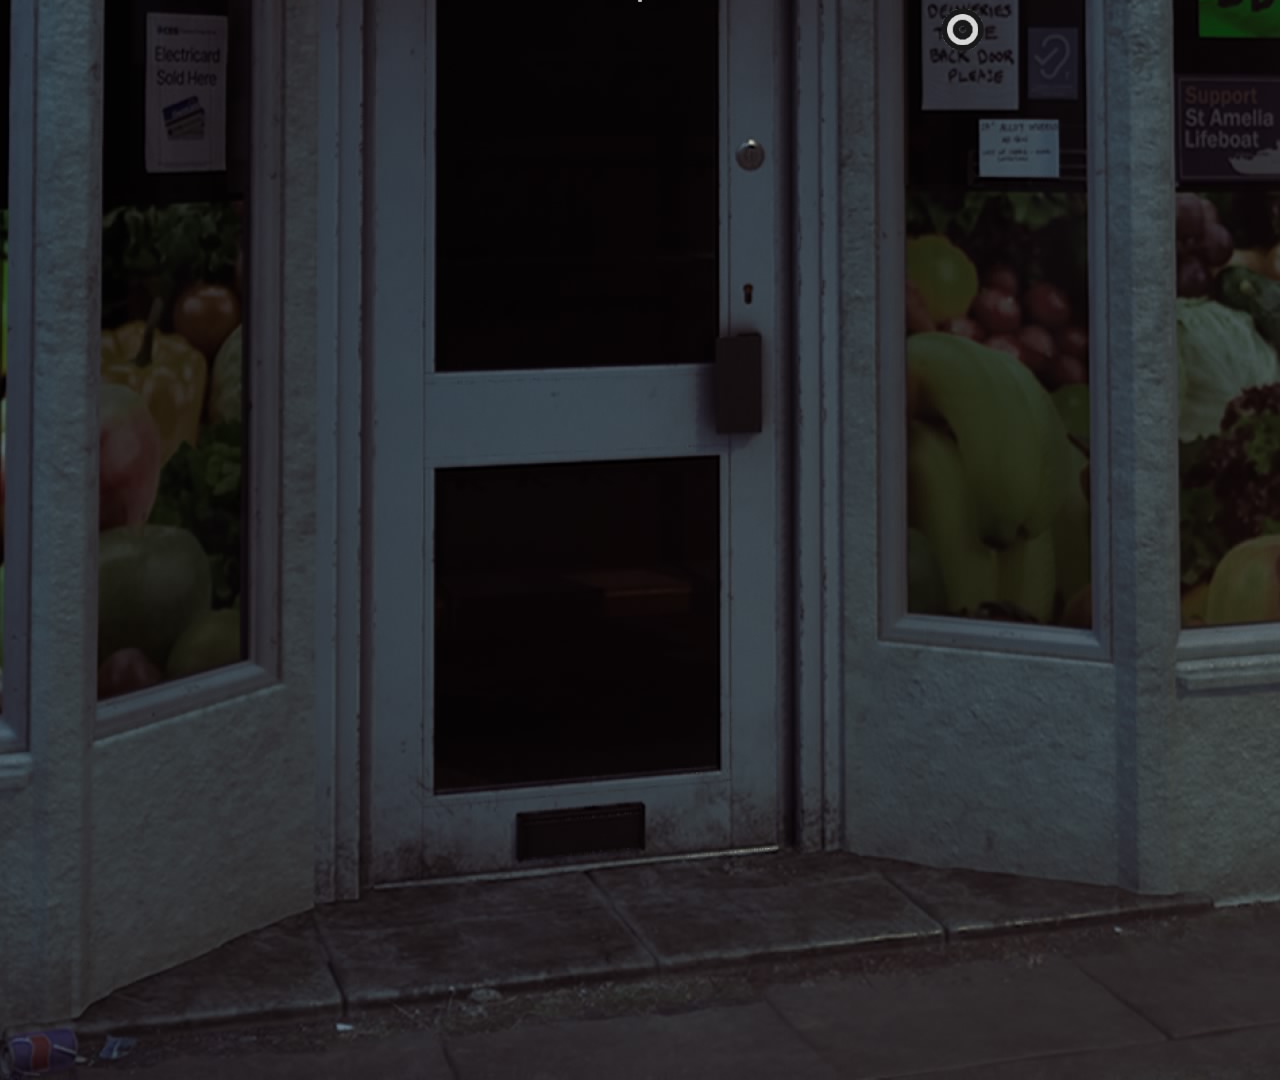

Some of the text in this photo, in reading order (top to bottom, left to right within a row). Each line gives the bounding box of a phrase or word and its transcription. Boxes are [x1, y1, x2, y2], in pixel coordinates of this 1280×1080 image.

[928, 3, 1011, 19] DEERIES
[155, 46, 220, 63] Electricard
[930, 47, 1014, 65] BACK DOOR
[157, 69, 217, 86] Sold Here
[948, 68, 1003, 84] PLEASE
[1185, 87, 1257, 106] Support
[1185, 108, 1274, 127] St Amelia
[1185, 130, 1259, 149] Lifeboat
